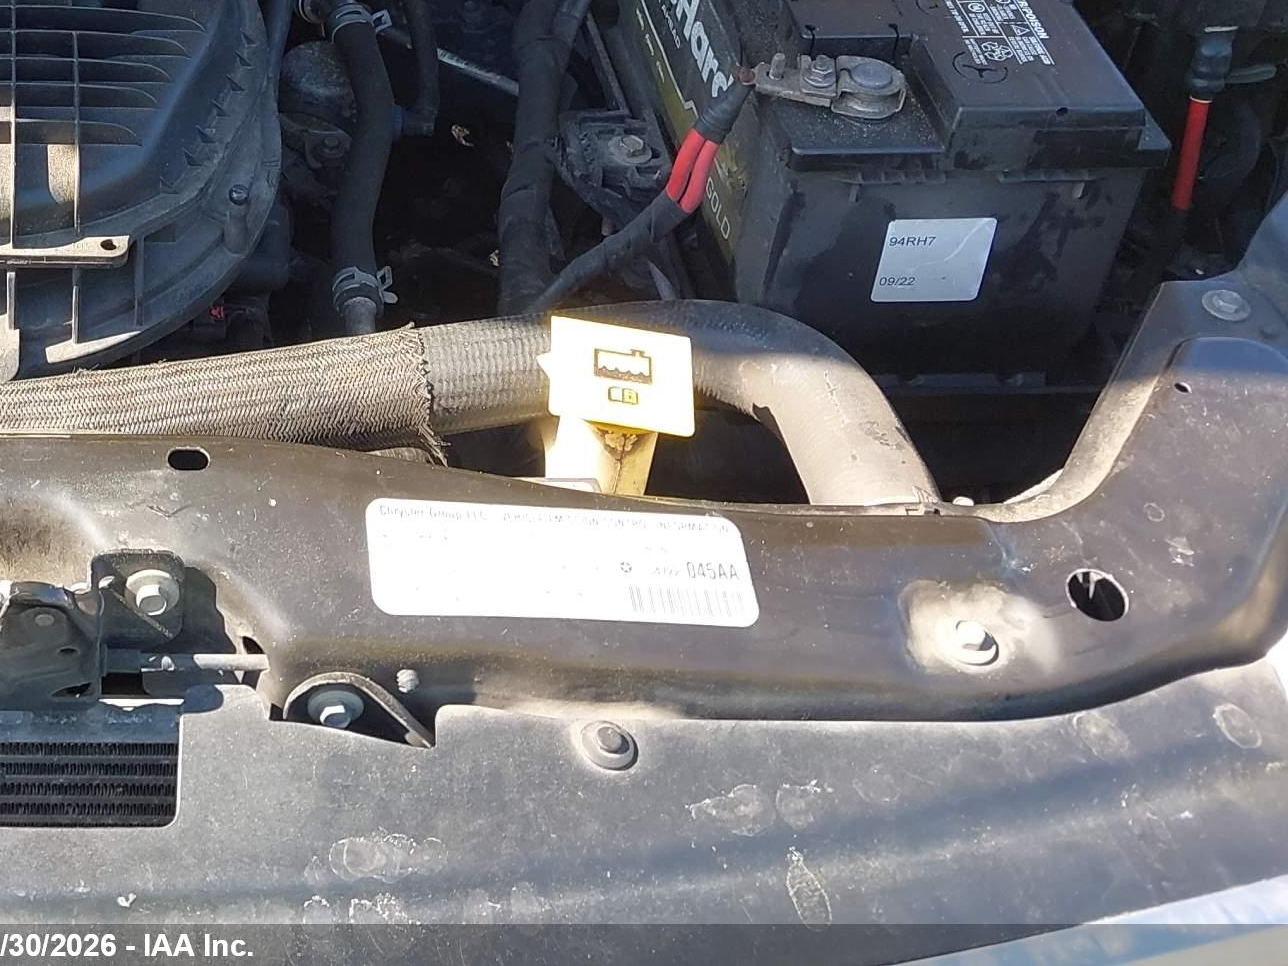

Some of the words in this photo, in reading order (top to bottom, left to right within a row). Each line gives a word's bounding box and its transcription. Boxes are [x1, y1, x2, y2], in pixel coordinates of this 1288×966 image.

[661, 4, 681, 50] AHEAD
[705, 176, 731, 240] GOLD
[889, 236, 936, 247] 94RH7
[879, 276, 916, 286] 09/22
[686, 562, 740, 580] 045AA
